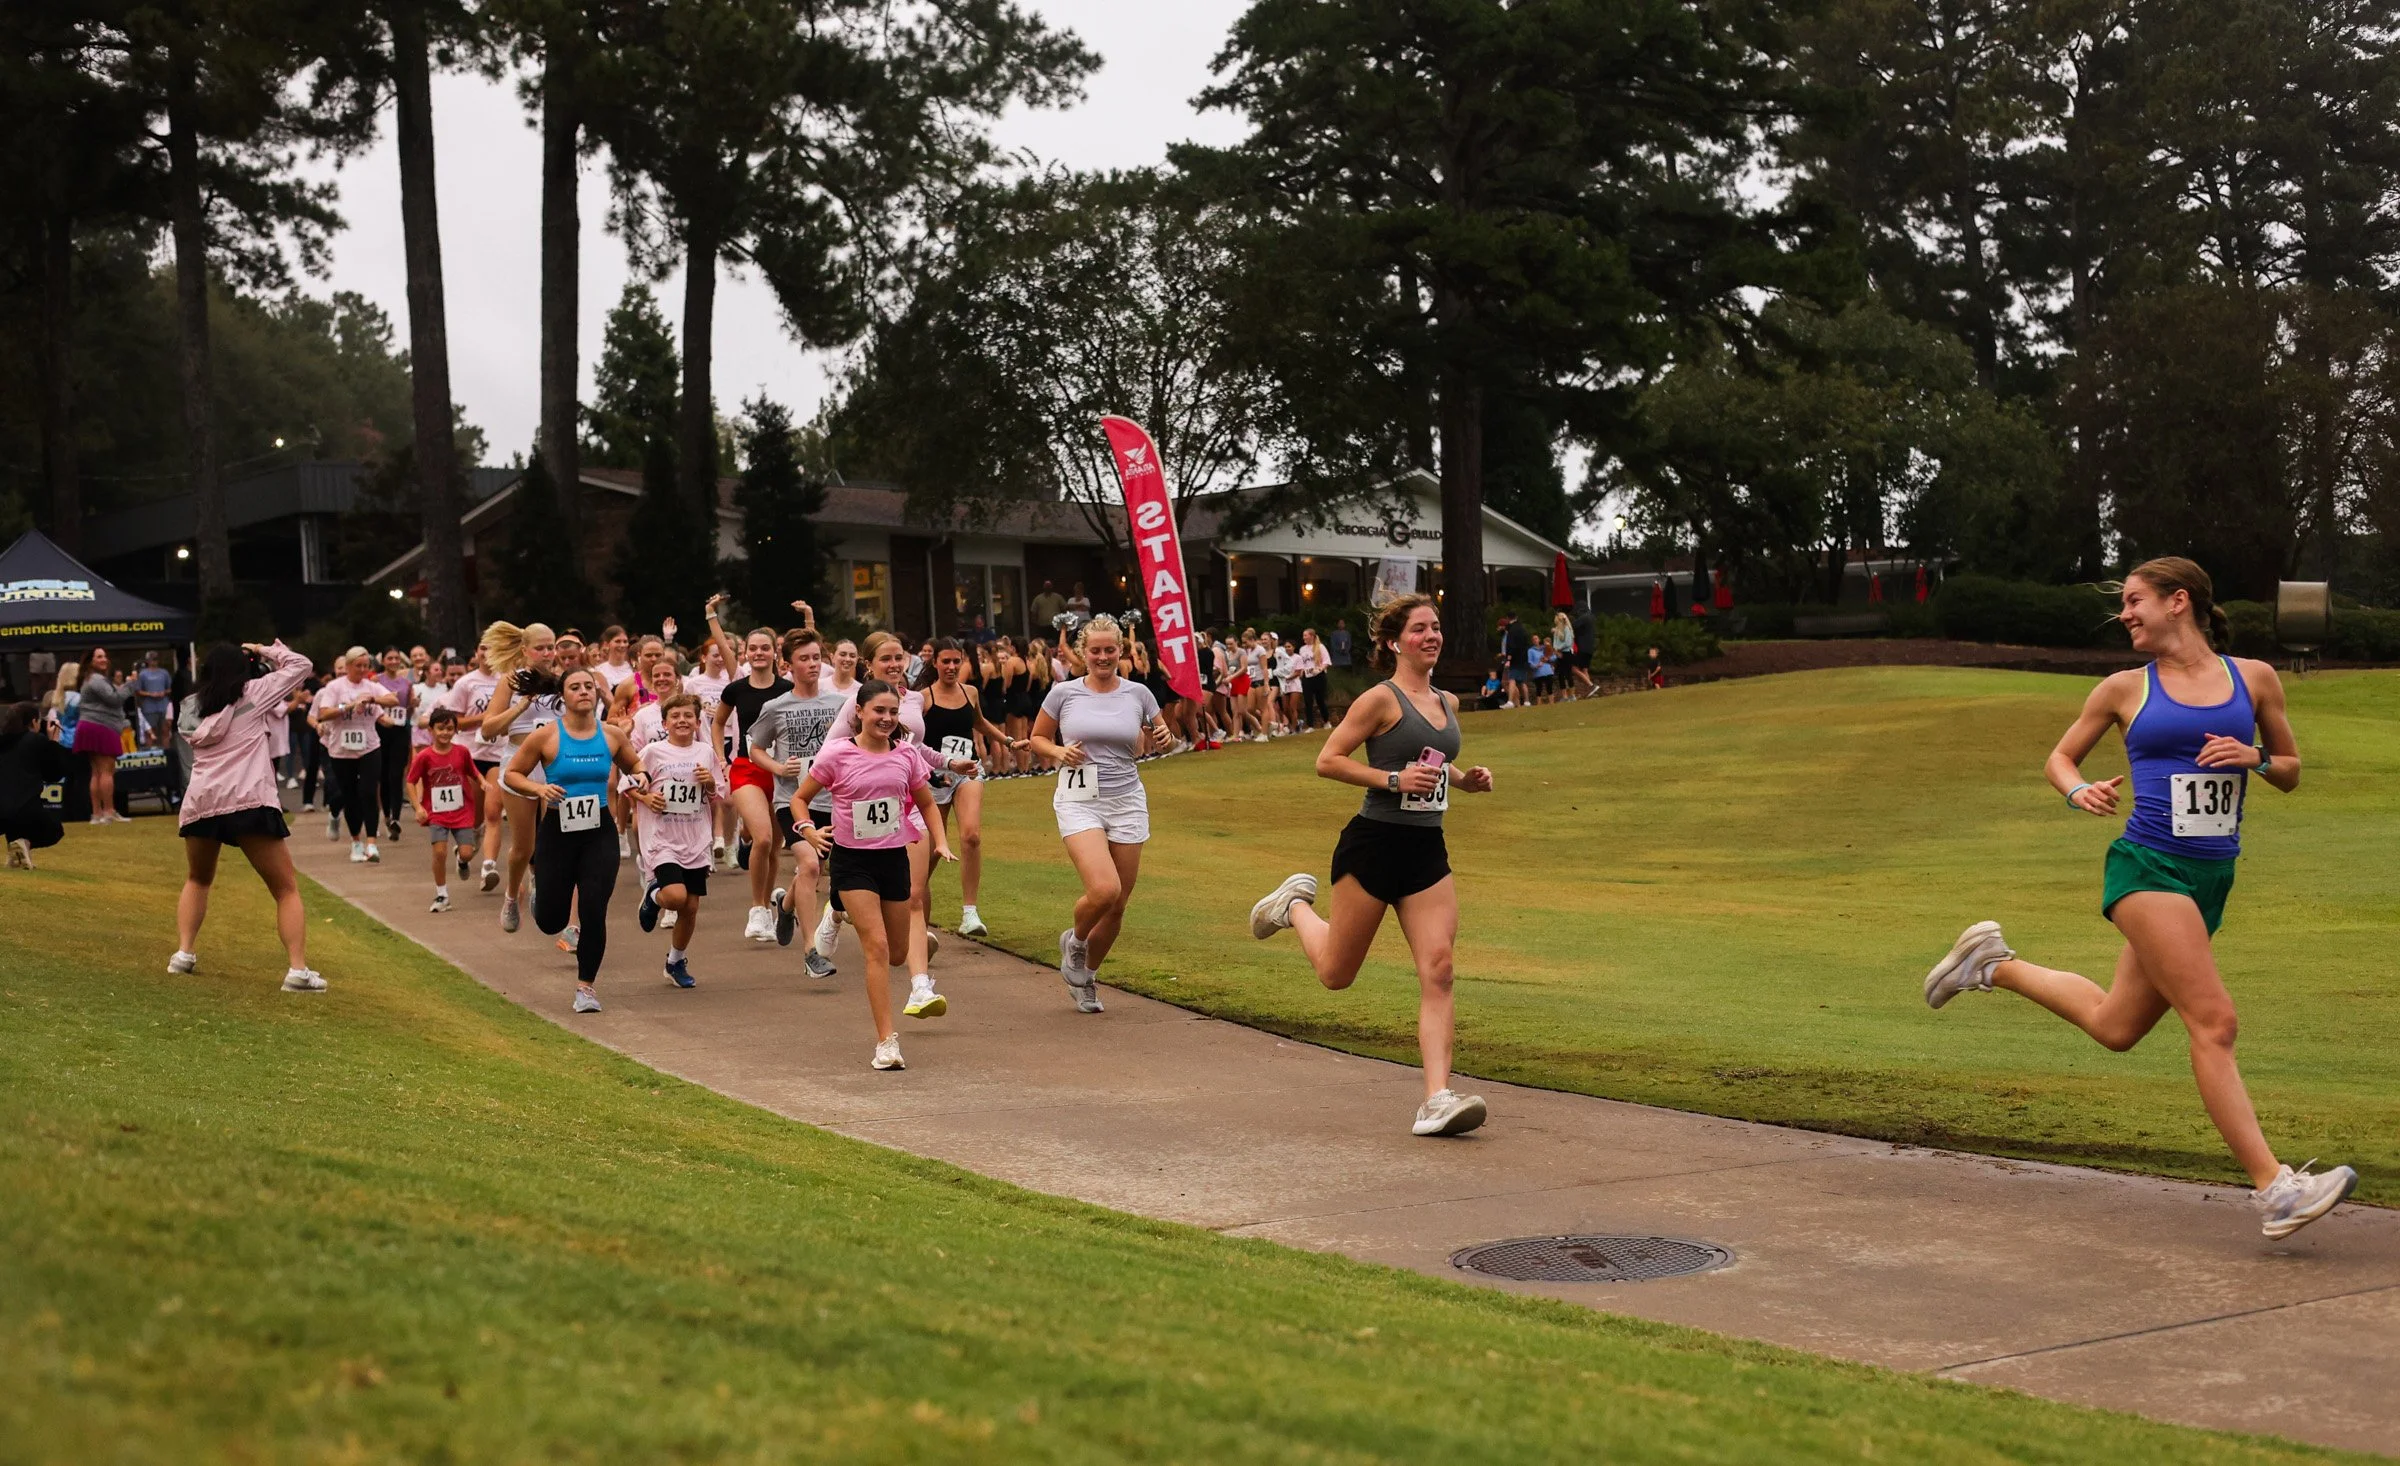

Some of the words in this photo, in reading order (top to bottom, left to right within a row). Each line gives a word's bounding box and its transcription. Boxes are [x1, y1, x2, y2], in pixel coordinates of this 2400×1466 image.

[0, 621, 164, 636] emenutritionusa.com
[786, 709, 812, 719] ATLANTA
[814, 708, 836, 717] BRAVES
[345, 732, 363, 743] 103
[951, 739, 966, 755] 74
[1067, 768, 1086, 789] 71
[440, 789, 455, 803] 41
[669, 784, 697, 804] 134
[2186, 780, 2234, 815] 138
[566, 799, 594, 820] 147
[867, 801, 889, 825] 43
